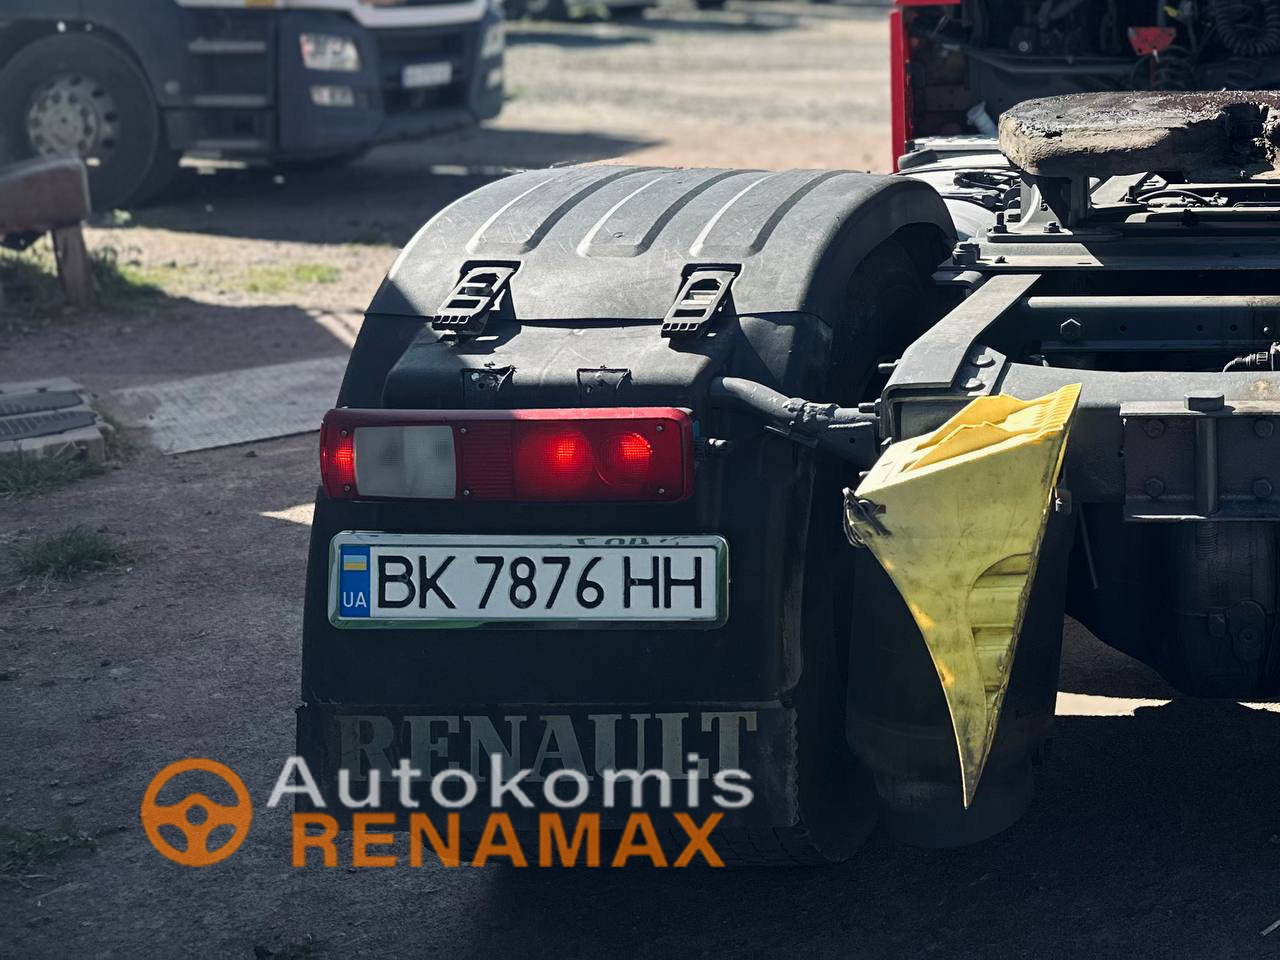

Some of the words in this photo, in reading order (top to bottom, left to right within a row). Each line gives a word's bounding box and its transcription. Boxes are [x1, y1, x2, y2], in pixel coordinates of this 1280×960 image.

[342, 590, 368, 609] UA
[377, 555, 457, 610] BK
[475, 555, 605, 610] 7876
[622, 555, 703, 610] HH
[335, 711, 758, 783] RENAULT
